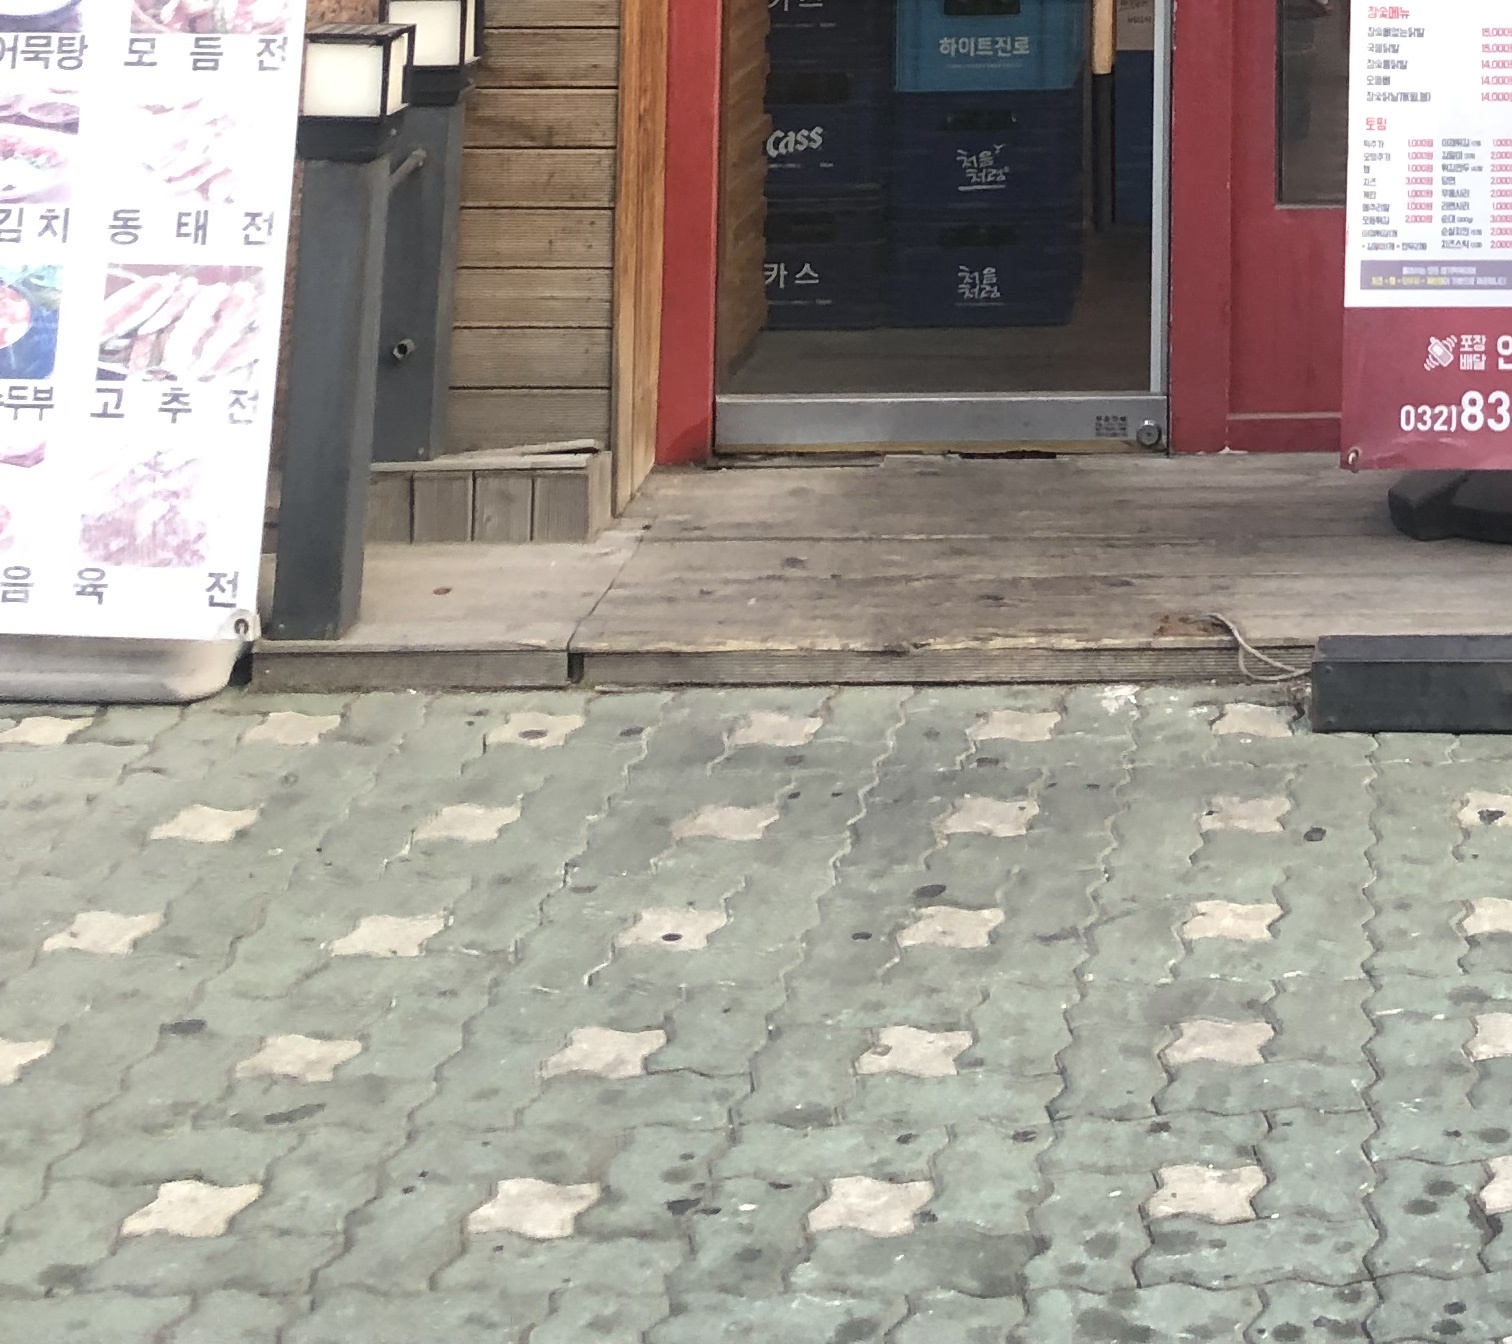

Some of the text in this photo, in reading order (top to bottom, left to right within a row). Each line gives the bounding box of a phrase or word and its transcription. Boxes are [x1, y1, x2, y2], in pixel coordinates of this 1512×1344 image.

[938, 35, 1031, 57] 하이트진로
[765, 125, 824, 158] Cass
[763, 262, 821, 289] 카스
[1459, 334, 1487, 352] 포장
[1459, 354, 1487, 371] 배달
[0, 385, 54, 421] 두부
